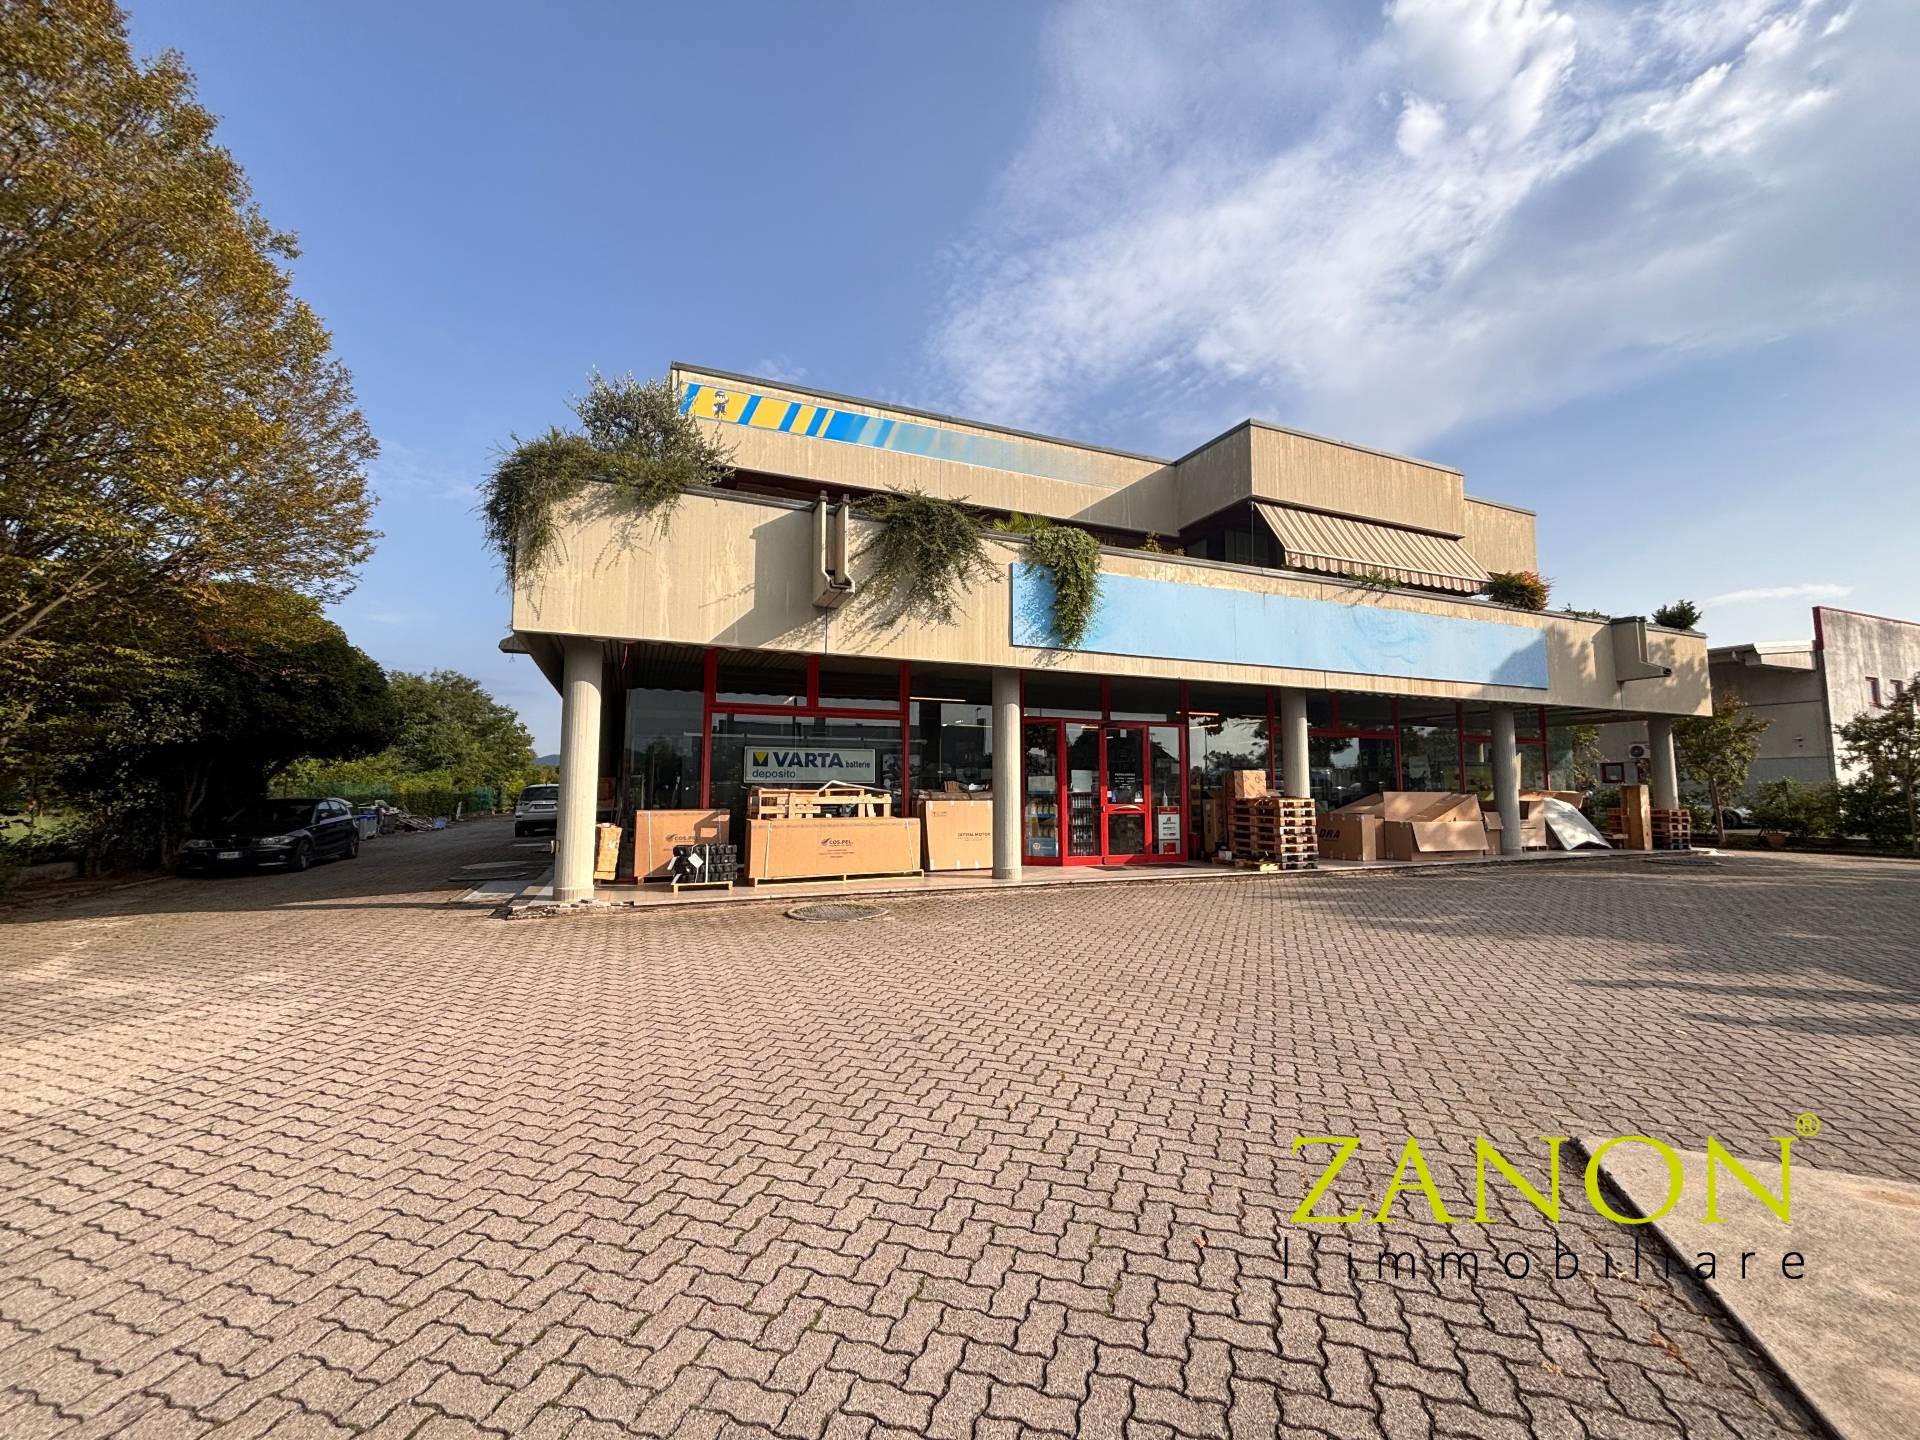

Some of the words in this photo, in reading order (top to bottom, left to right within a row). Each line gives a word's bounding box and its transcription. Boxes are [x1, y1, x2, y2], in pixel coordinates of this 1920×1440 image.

[772, 751, 844, 768] VARTA
[845, 761, 871, 769] batterie
[752, 768, 796, 779] deposito
